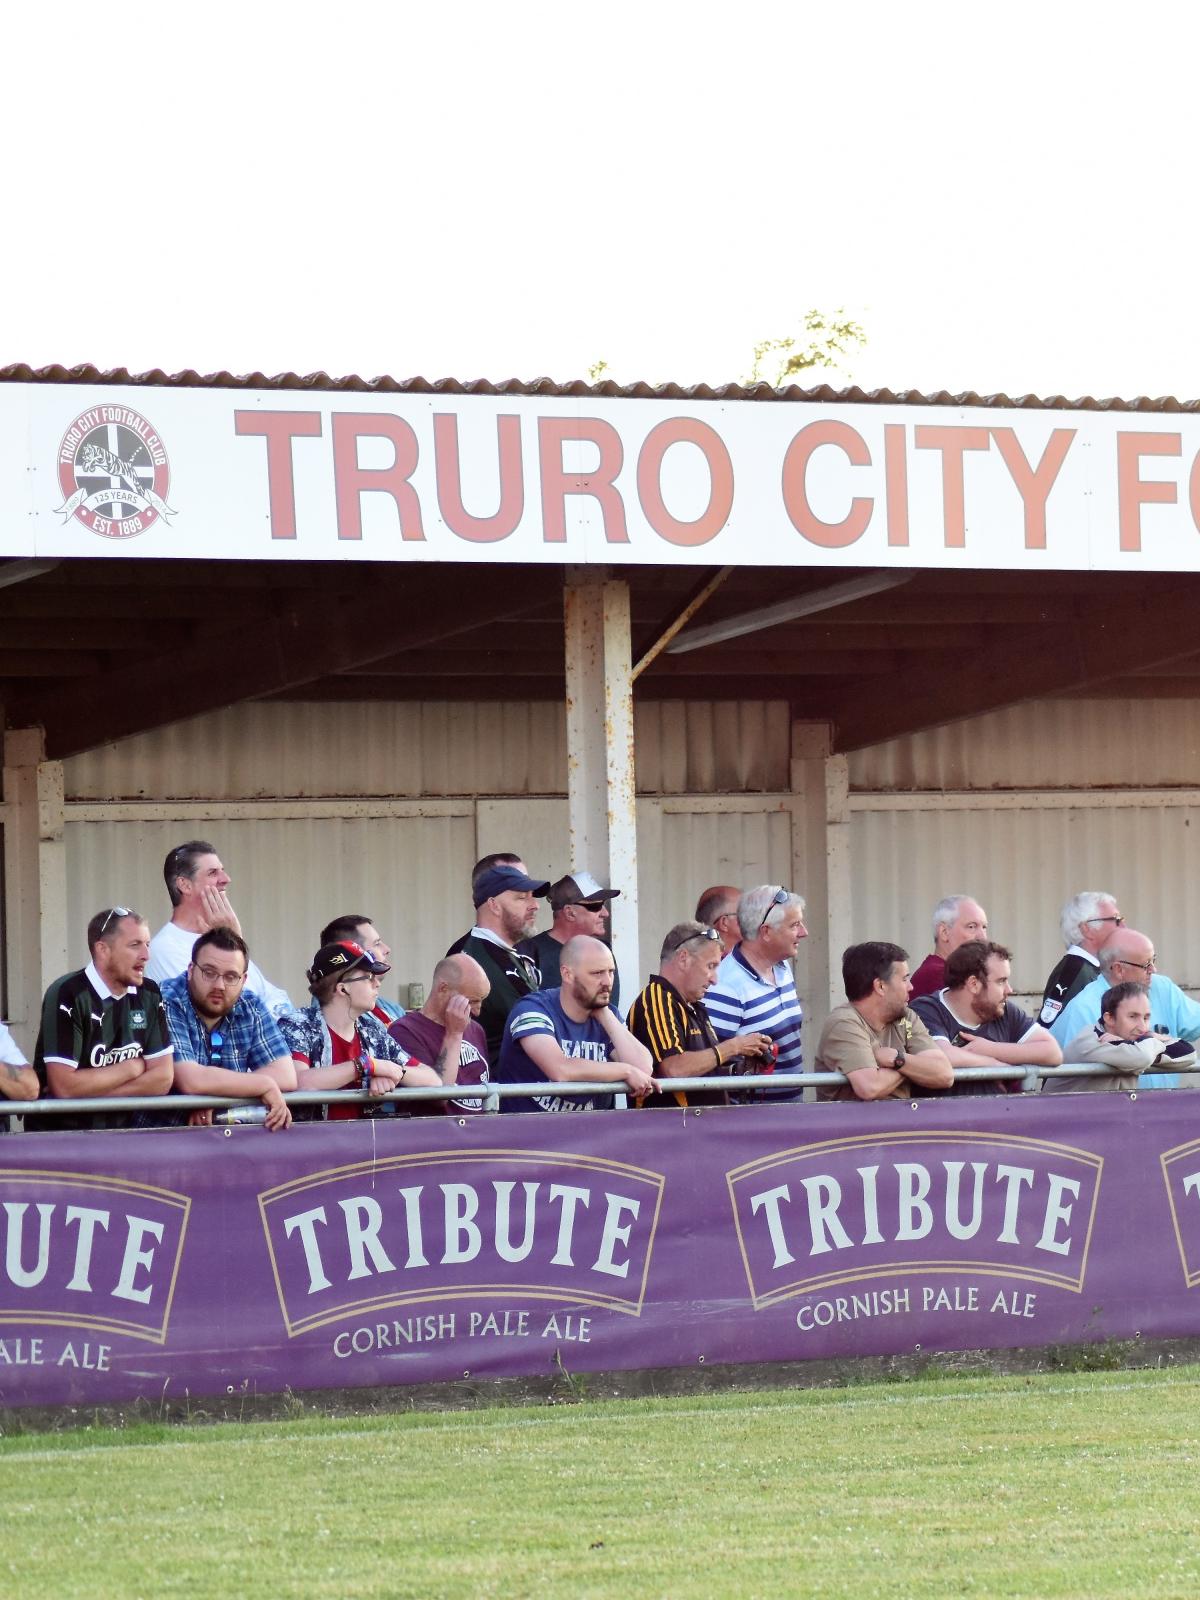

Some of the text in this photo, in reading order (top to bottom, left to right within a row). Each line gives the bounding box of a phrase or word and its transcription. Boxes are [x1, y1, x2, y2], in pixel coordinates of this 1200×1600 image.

[60, 407, 166, 466] TRURO CITY FOOTBALL CLUB
[94, 492, 110, 503] 125
[110, 491, 138, 504] YEARS
[234, 409, 733, 545] TRURO
[782, 420, 1076, 549] CITY
[92, 516, 143, 536] EST. 1889
[283, 1180, 641, 1295] TRIBUTE
[750, 1160, 1081, 1270] TRIBUTE
[796, 1286, 1037, 1331] CORNISH PALE ALE
[57, 1341, 112, 1372] ALE
[333, 1311, 592, 1358] CORNISH PALE ALE
